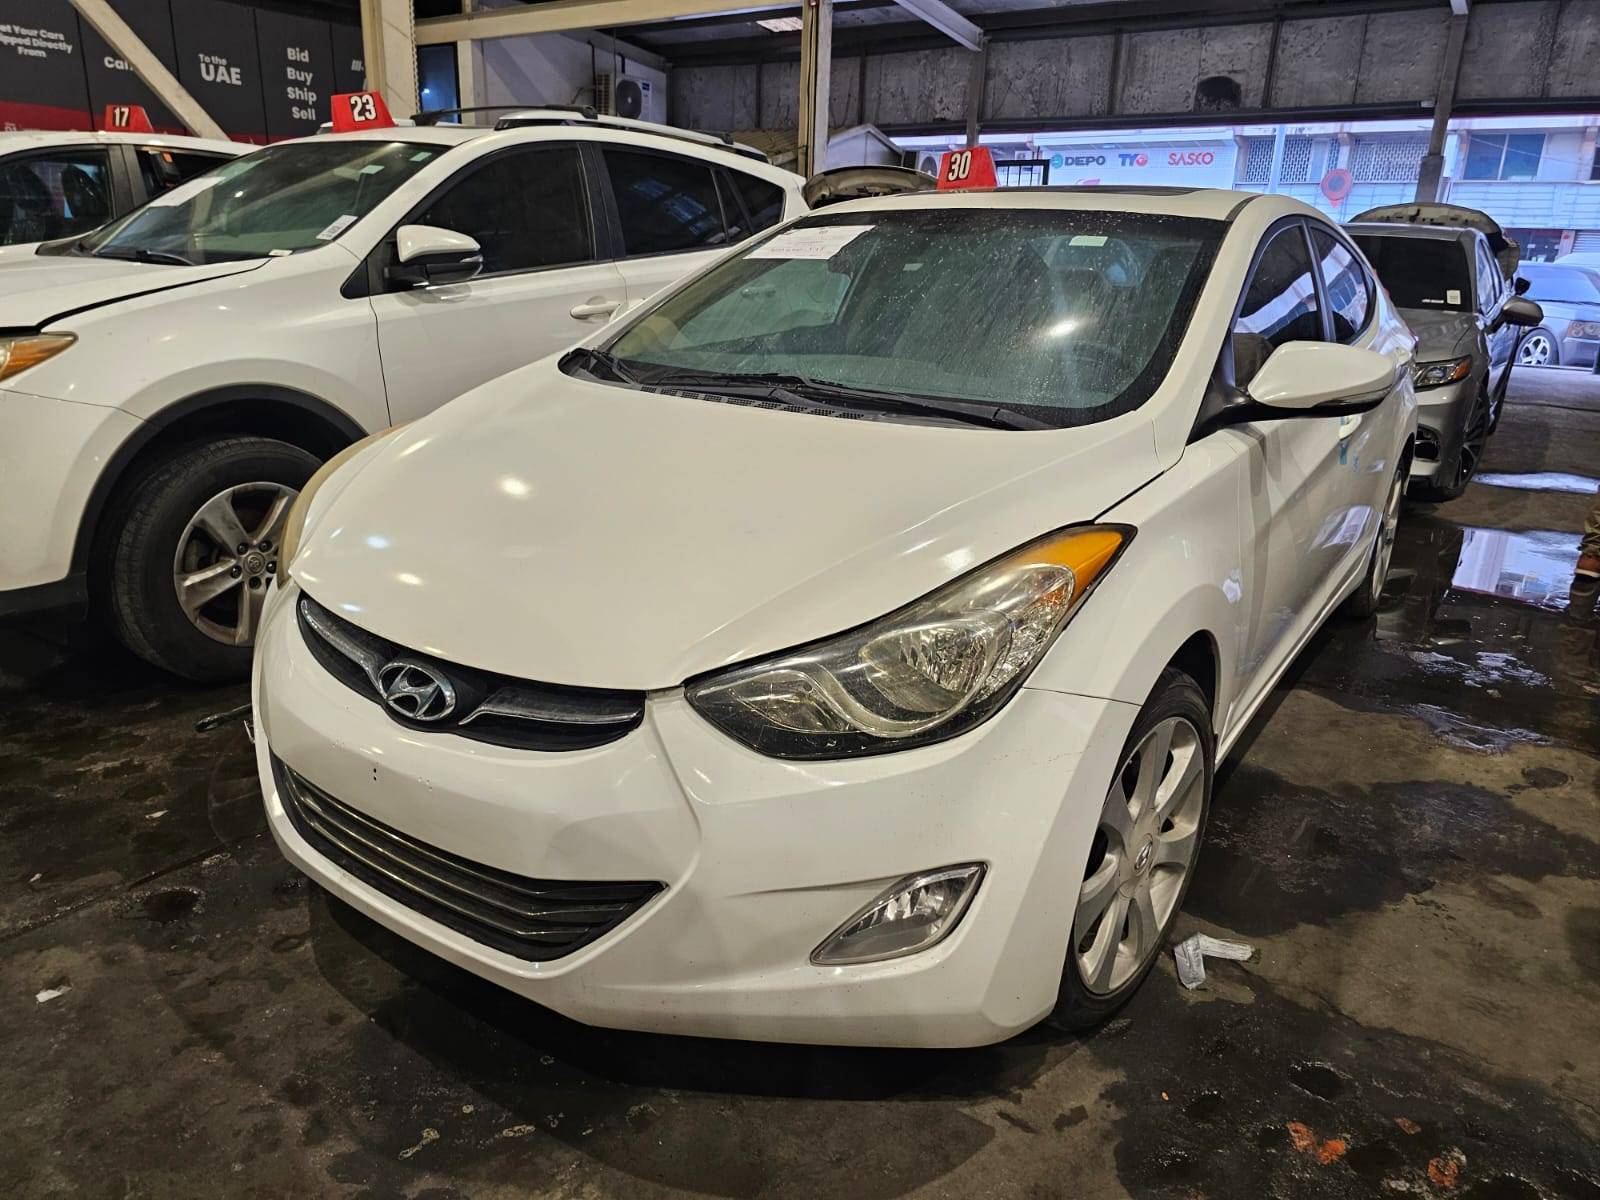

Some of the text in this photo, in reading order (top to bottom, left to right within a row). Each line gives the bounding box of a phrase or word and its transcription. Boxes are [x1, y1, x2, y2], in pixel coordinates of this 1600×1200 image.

[0, 24, 65, 41] et Your Cars
[0, 32, 73, 54] ipped Directly
[17, 46, 47, 58] From
[198, 53, 227, 65] To the
[287, 48, 309, 62] Bid
[200, 63, 242, 85] UAE
[287, 67, 313, 85] Buy
[287, 87, 317, 103] Ship
[292, 106, 316, 120] Sell
[350, 94, 377, 121] 23
[114, 107, 129, 127] 17
[948, 151, 971, 181] 30
[1065, 155, 1106, 166] DEPO
[1168, 152, 1214, 165] SASCO
